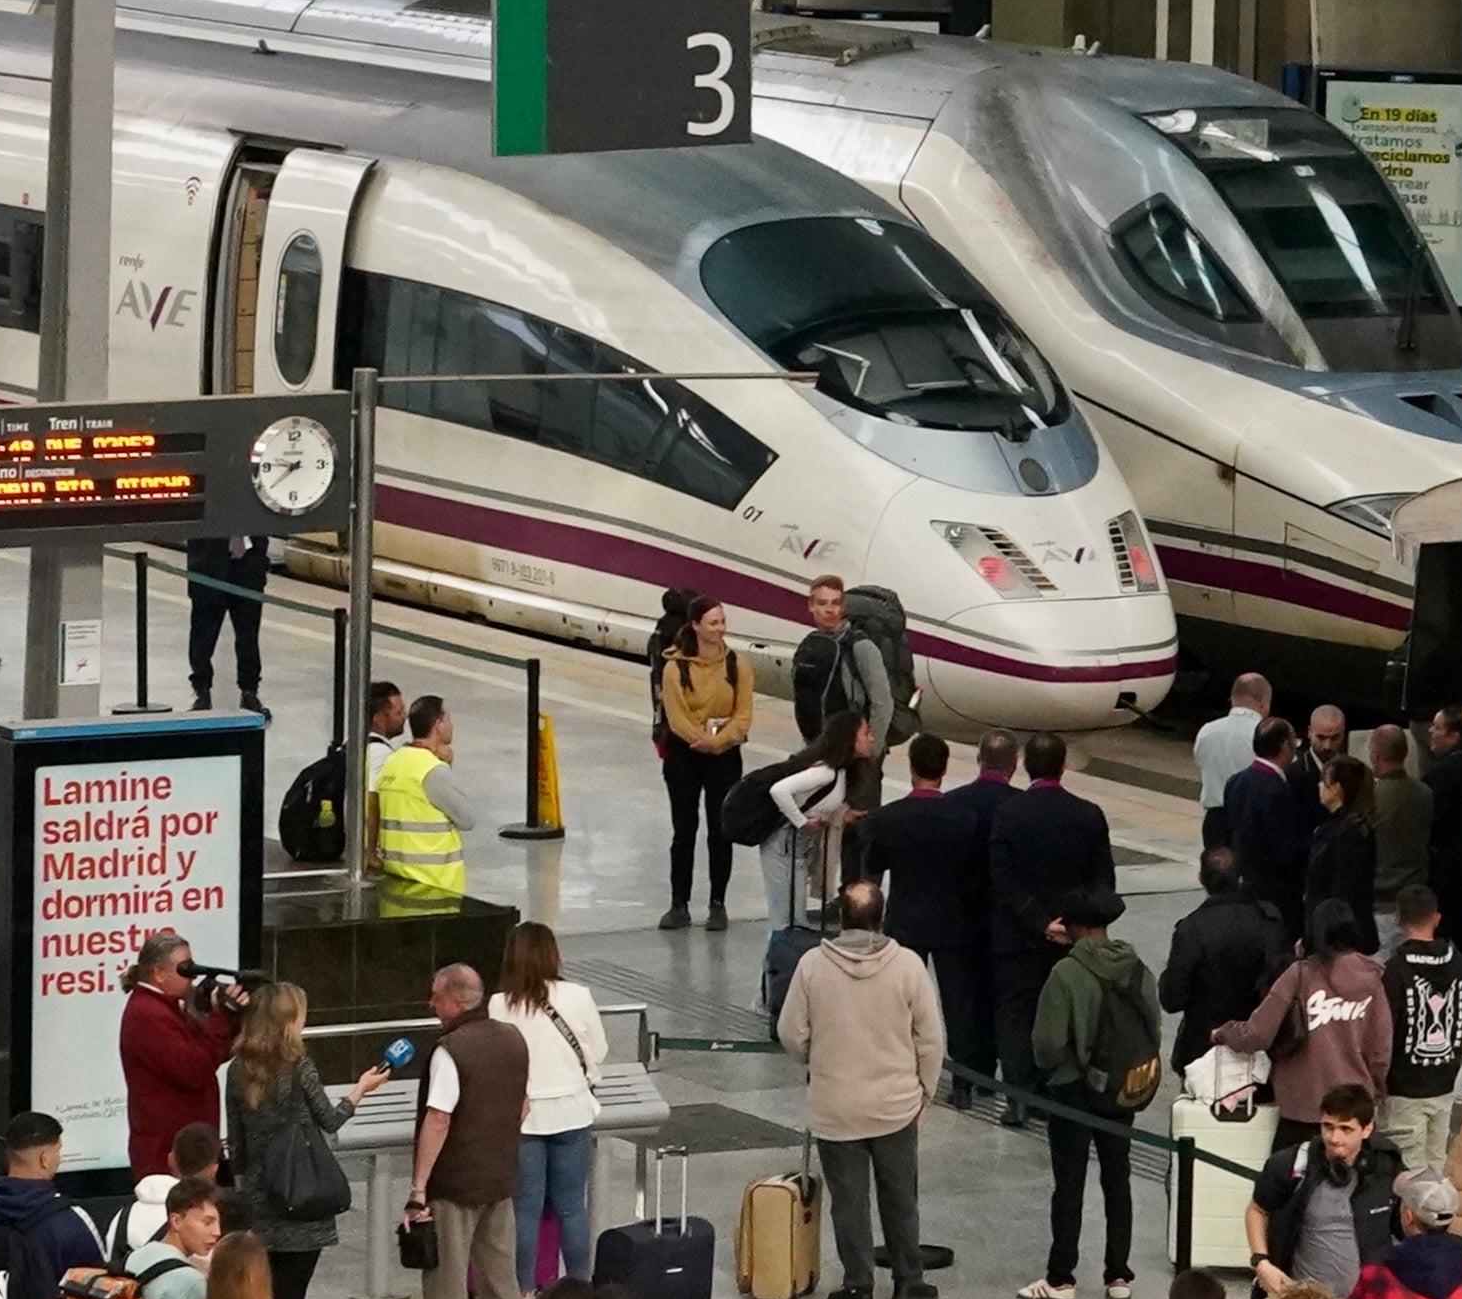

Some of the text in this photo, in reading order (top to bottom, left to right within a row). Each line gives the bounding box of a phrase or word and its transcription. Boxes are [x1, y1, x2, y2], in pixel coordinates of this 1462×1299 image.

[686, 32, 735, 136] 3
[1361, 107, 1438, 123] En 19 días
[116, 279, 198, 332] AVE
[7, 423, 29, 432] TIME
[49, 417, 78, 430] Tren
[85, 419, 113, 429] TRAIN
[742, 505, 764, 523] 01
[44, 771, 172, 806] Lamine
[43, 805, 219, 845] saldrá por
[43, 845, 197, 882] Madrid y
[42, 879, 224, 920] dormirá en
